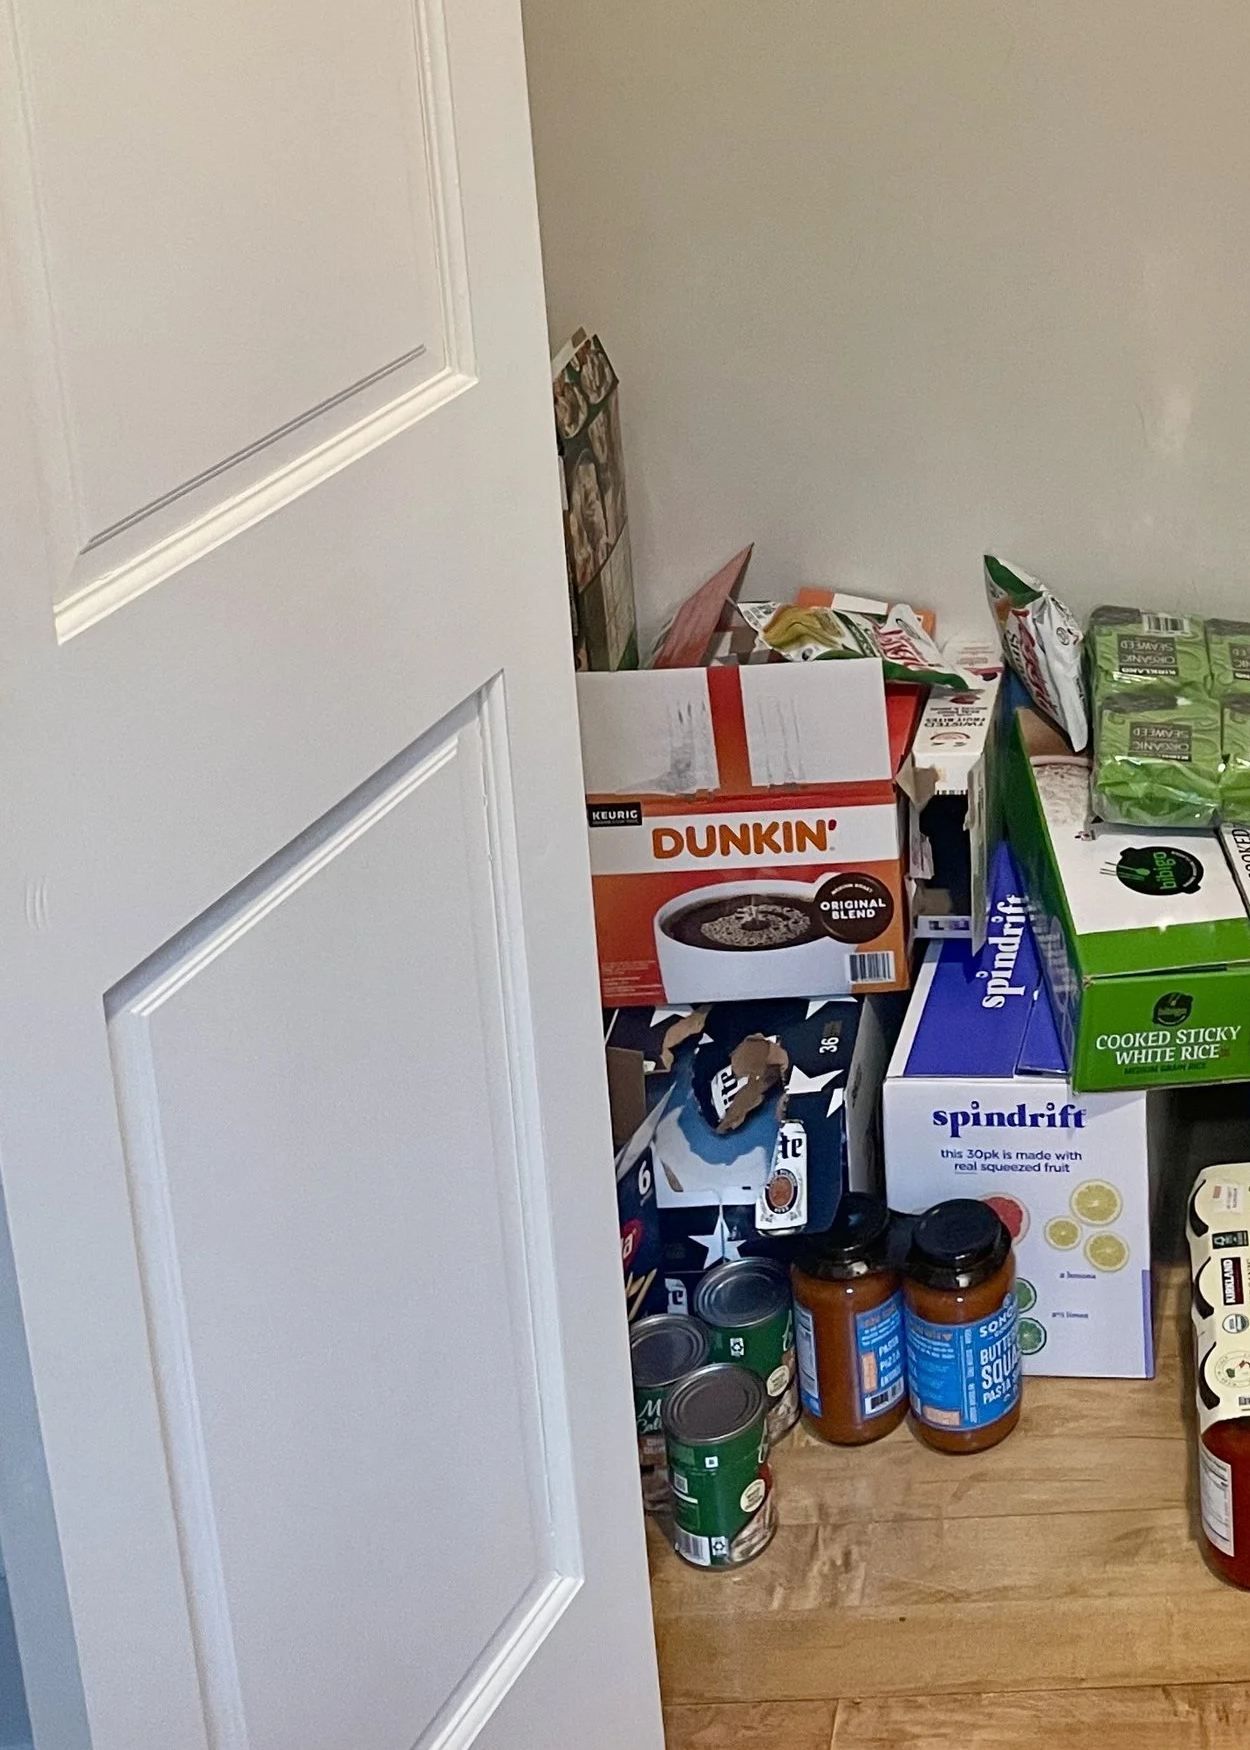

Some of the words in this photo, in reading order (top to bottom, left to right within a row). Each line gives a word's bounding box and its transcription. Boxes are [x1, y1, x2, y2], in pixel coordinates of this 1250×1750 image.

[1120, 639, 1175, 652] SEAWEED
[1120, 652, 1177, 664] ORGANIC
[1132, 728, 1190, 739] SEAWEED
[1133, 741, 1190, 751] ORGANIC
[591, 809, 639, 821] KEURIG
[652, 819, 838, 860] DUNKIN'
[1152, 850, 1177, 891] bibigo
[819, 897, 887, 911] ORIGINAL
[831, 908, 877, 921] BLEND
[975, 894, 1026, 1009] spindrift
[818, 1036, 840, 1054] 36
[1096, 1029, 1171, 1051] COOKED
[1175, 1024, 1242, 1042] STICKY
[1114, 1048, 1178, 1066] WHITE
[1181, 1044, 1221, 1061] RICE
[932, 1100, 1086, 1139] spindrift
[940, 1149, 964, 1160] this
[967, 1149, 1000, 1162] 30pk
[1003, 1150, 1013, 1160] is
[1015, 1150, 1052, 1161] made
[1055, 1151, 1083, 1161] with
[954, 1161, 978, 1172] real
[980, 1162, 1042, 1173] squeezed
[1044, 1162, 1071, 1173] fruit
[637, 1159, 651, 1195] 6
[1222, 1258, 1236, 1304] KIRKLAND
